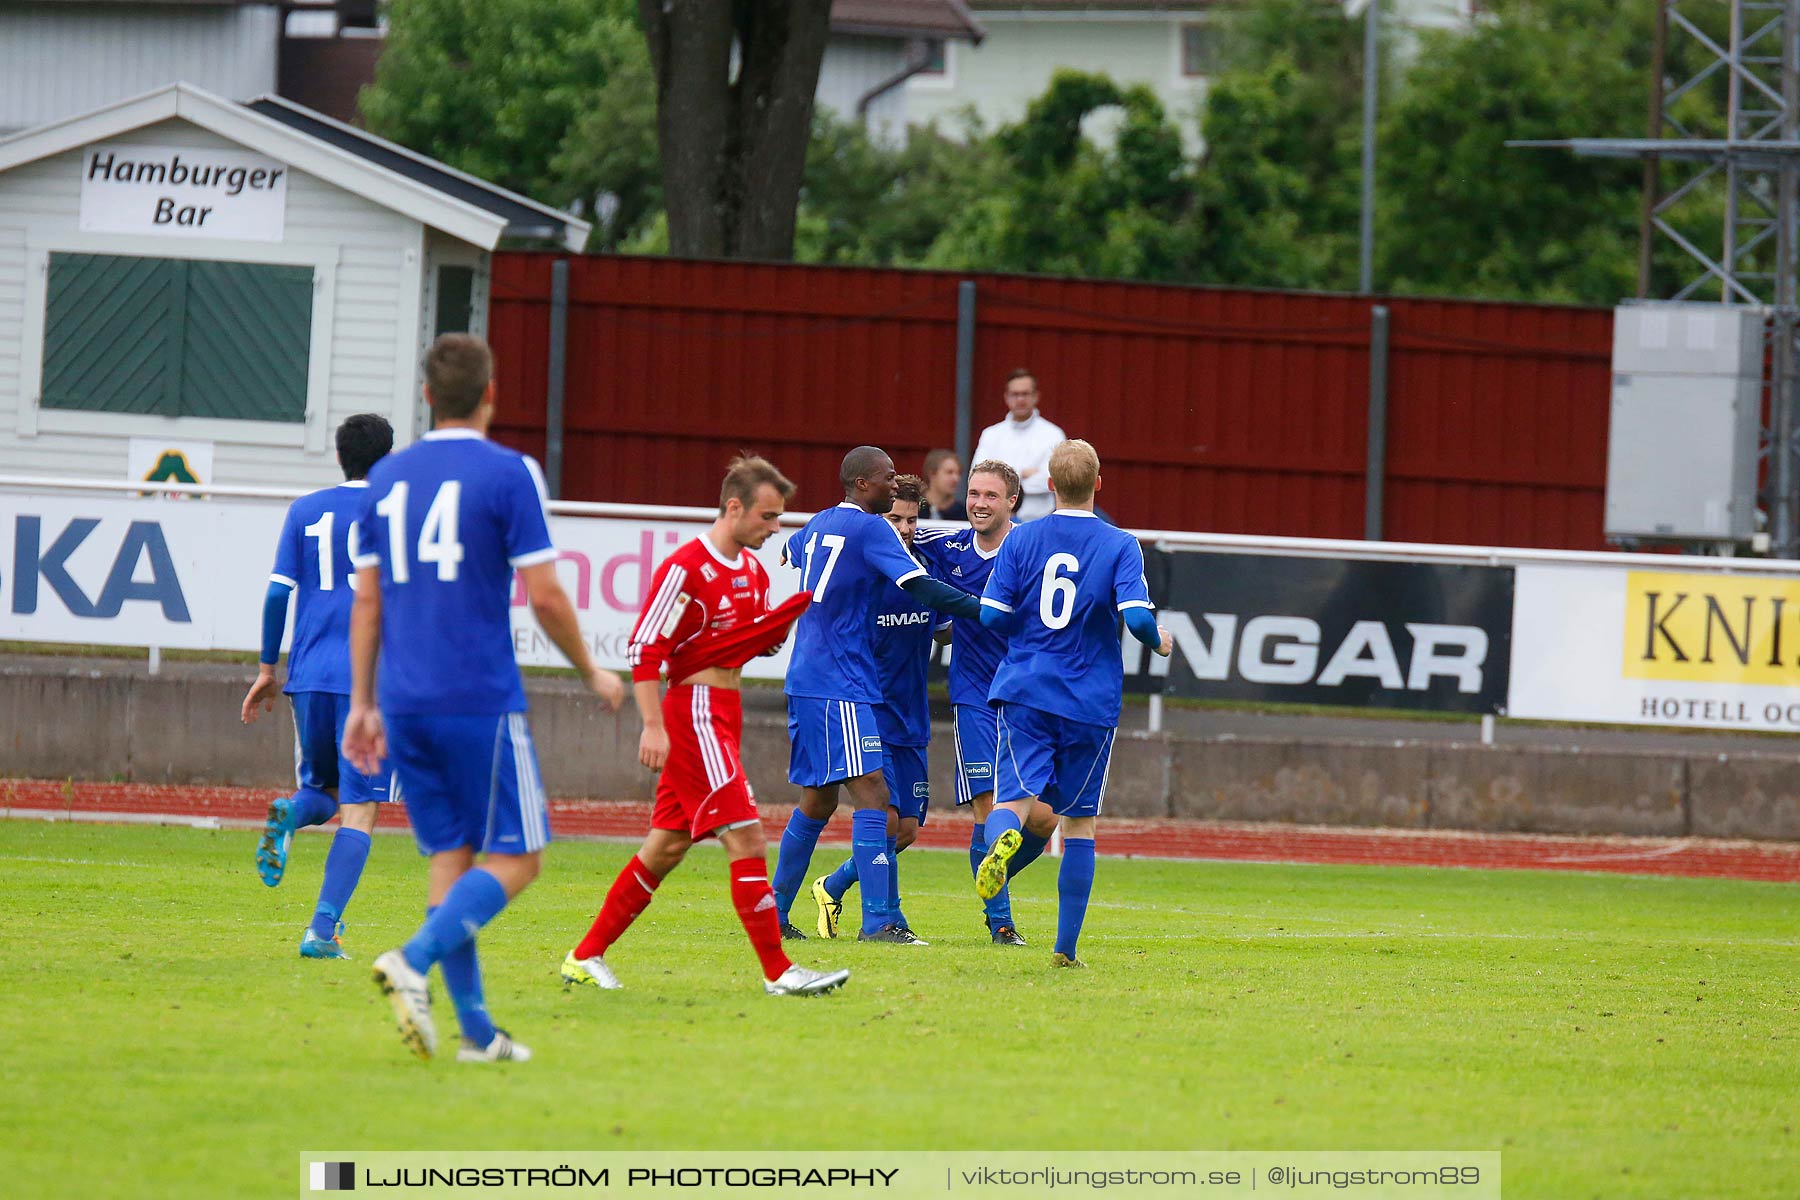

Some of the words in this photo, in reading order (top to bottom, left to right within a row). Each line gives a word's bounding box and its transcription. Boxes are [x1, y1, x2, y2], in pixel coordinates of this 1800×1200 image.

[87, 152, 284, 196] Hamburger
[152, 197, 213, 227] Bar
[376, 480, 465, 584] 14
[803, 530, 846, 603] 17
[1039, 552, 1080, 630] 6
[1640, 591, 1800, 667] KNI
[1640, 697, 1752, 722] HOTELL
